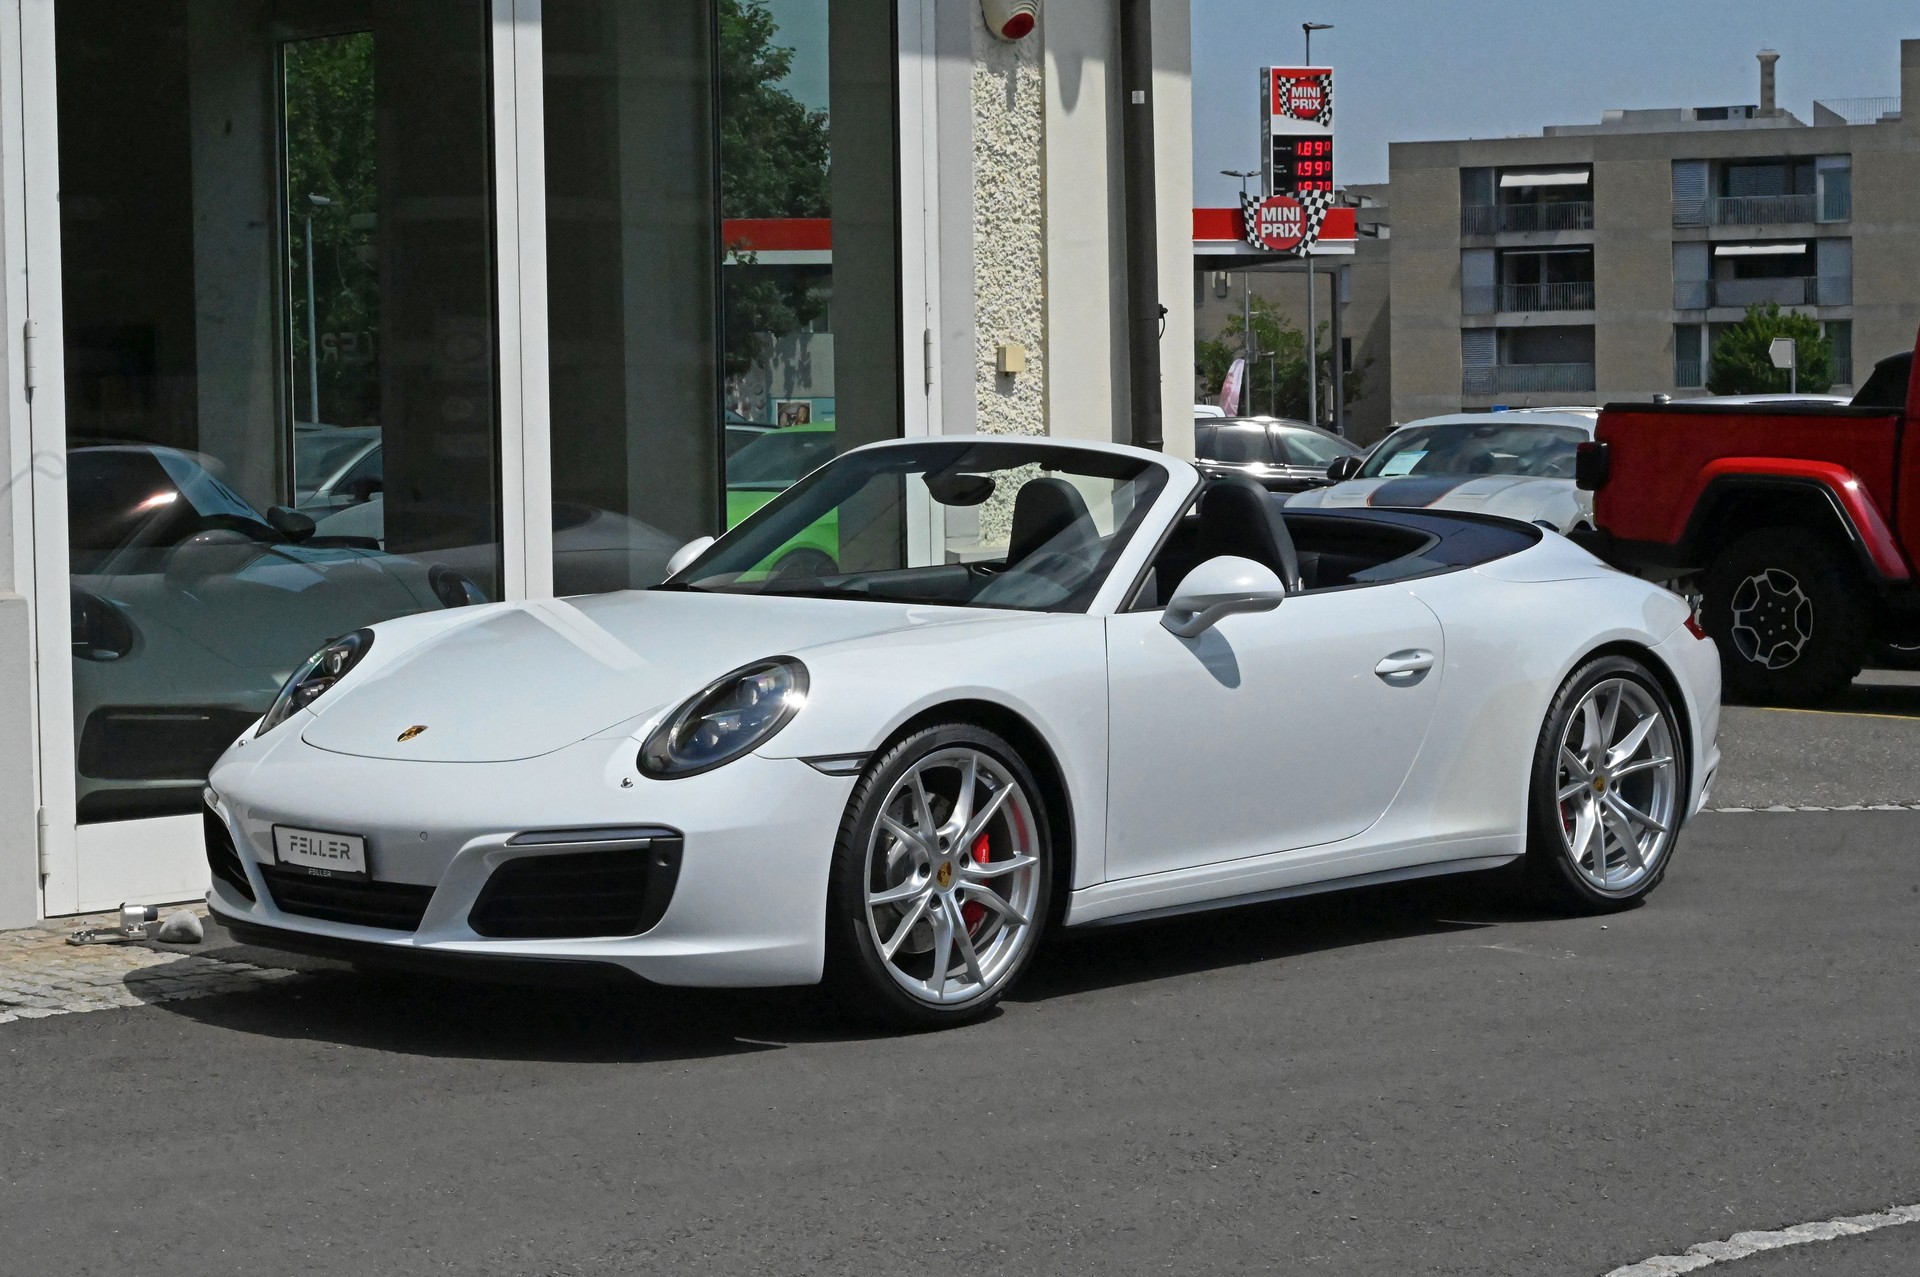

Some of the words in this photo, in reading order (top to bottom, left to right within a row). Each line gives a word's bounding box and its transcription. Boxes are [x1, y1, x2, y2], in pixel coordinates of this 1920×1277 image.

[1291, 86, 1320, 98] MINI
[1291, 98, 1321, 110] PRIX
[1261, 206, 1301, 222] MINI
[1261, 223, 1302, 238] PRIX
[290, 835, 351, 860] FELLER
[308, 867, 332, 878] FELLER
